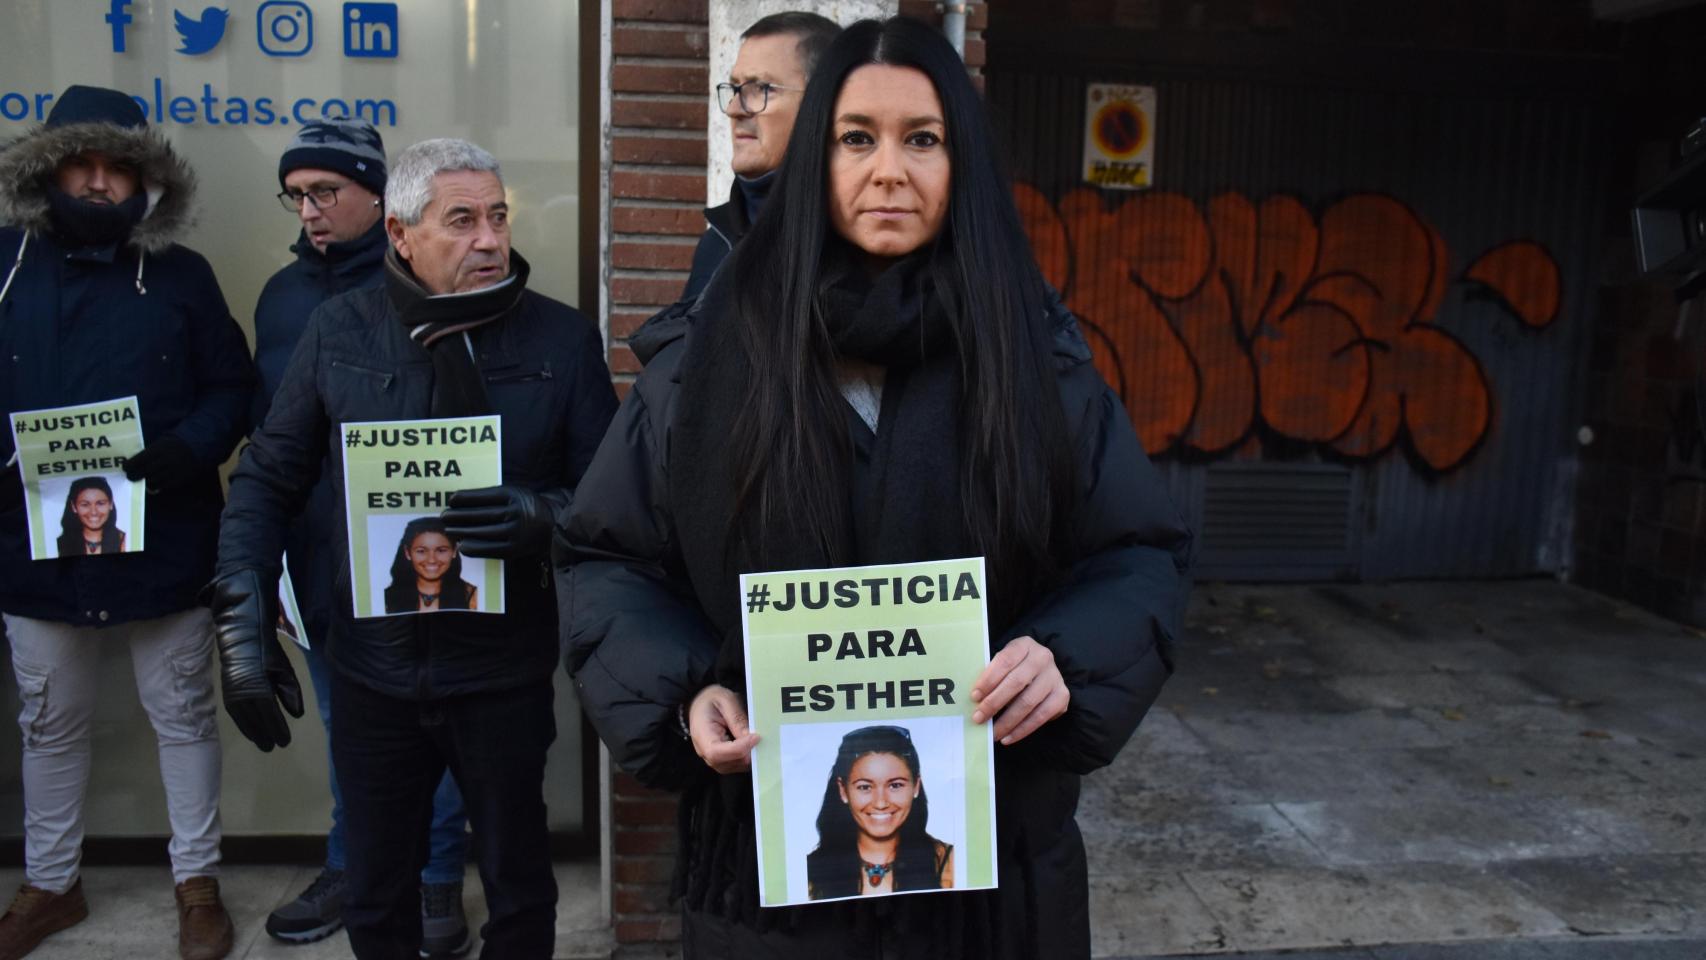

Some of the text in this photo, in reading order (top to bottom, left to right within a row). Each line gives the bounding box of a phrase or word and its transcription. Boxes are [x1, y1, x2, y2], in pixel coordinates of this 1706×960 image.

[15, 407, 136, 434] #JUSTICIA
[49, 435, 111, 452] PARA
[346, 425, 497, 448] #JUSTICIA
[385, 459, 462, 478] PARA
[367, 491, 456, 509] ESTH
[747, 572, 980, 613] #JUSTICIA
[807, 628, 927, 661] PARA
[780, 678, 956, 713] ESTHER
